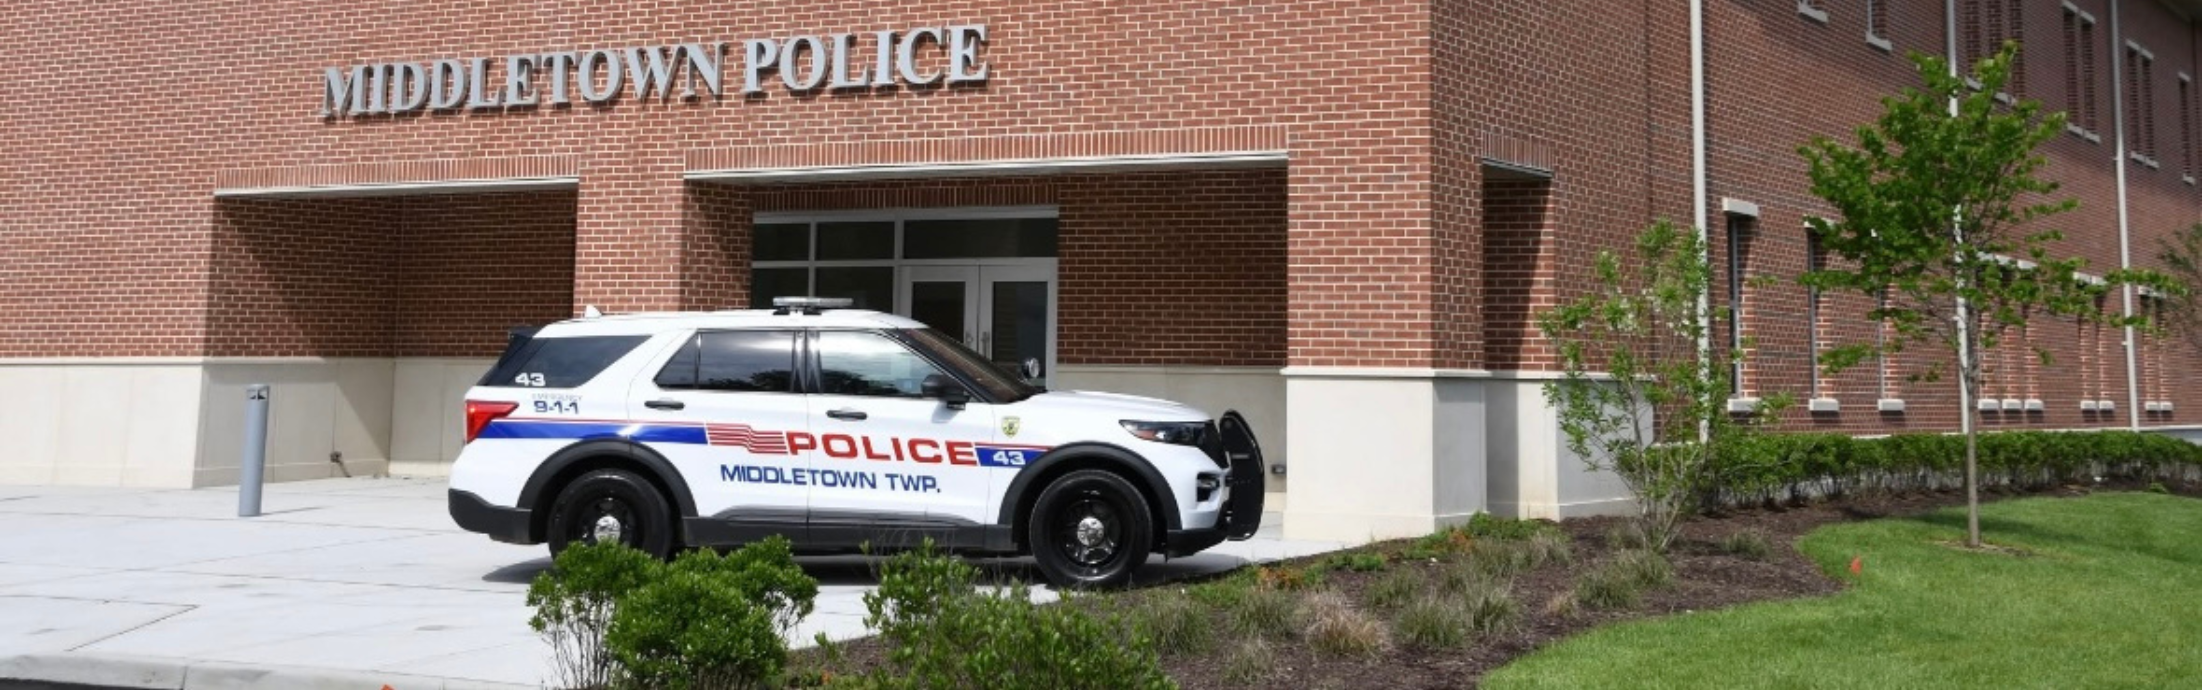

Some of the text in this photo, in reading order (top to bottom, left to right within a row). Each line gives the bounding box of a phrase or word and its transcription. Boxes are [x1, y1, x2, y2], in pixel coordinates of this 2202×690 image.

[322, 23, 989, 118] MIDDLETOWN POLICE
[515, 372, 546, 387] 43
[534, 400, 579, 415] 9-1-1
[785, 431, 978, 466] POLICE
[992, 450, 1026, 466] 43
[719, 464, 941, 494] MIDDLETOWN TWP.
